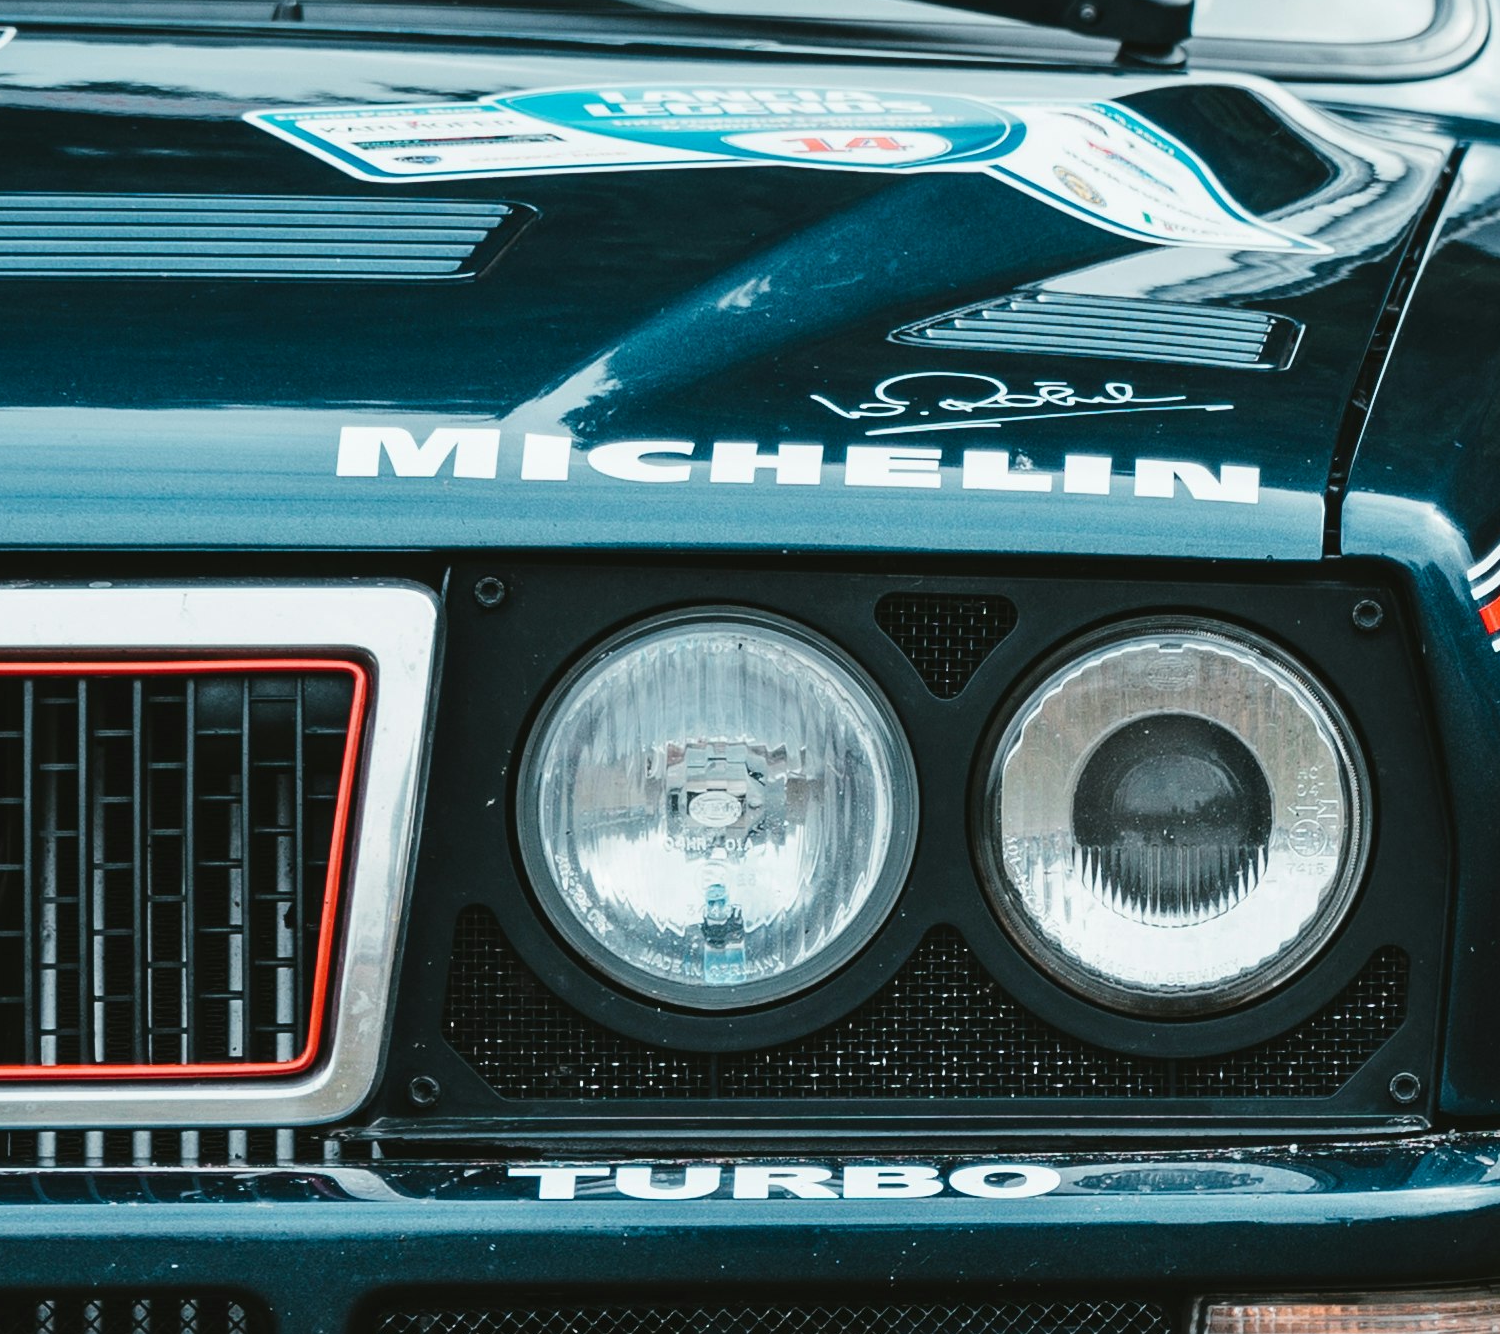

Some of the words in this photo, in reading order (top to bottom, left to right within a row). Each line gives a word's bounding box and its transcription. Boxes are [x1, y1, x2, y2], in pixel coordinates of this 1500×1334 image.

[780, 136, 900, 154] 14
[336, 425, 1260, 504] MICHELIN
[507, 1166, 1061, 1200] TURBO
